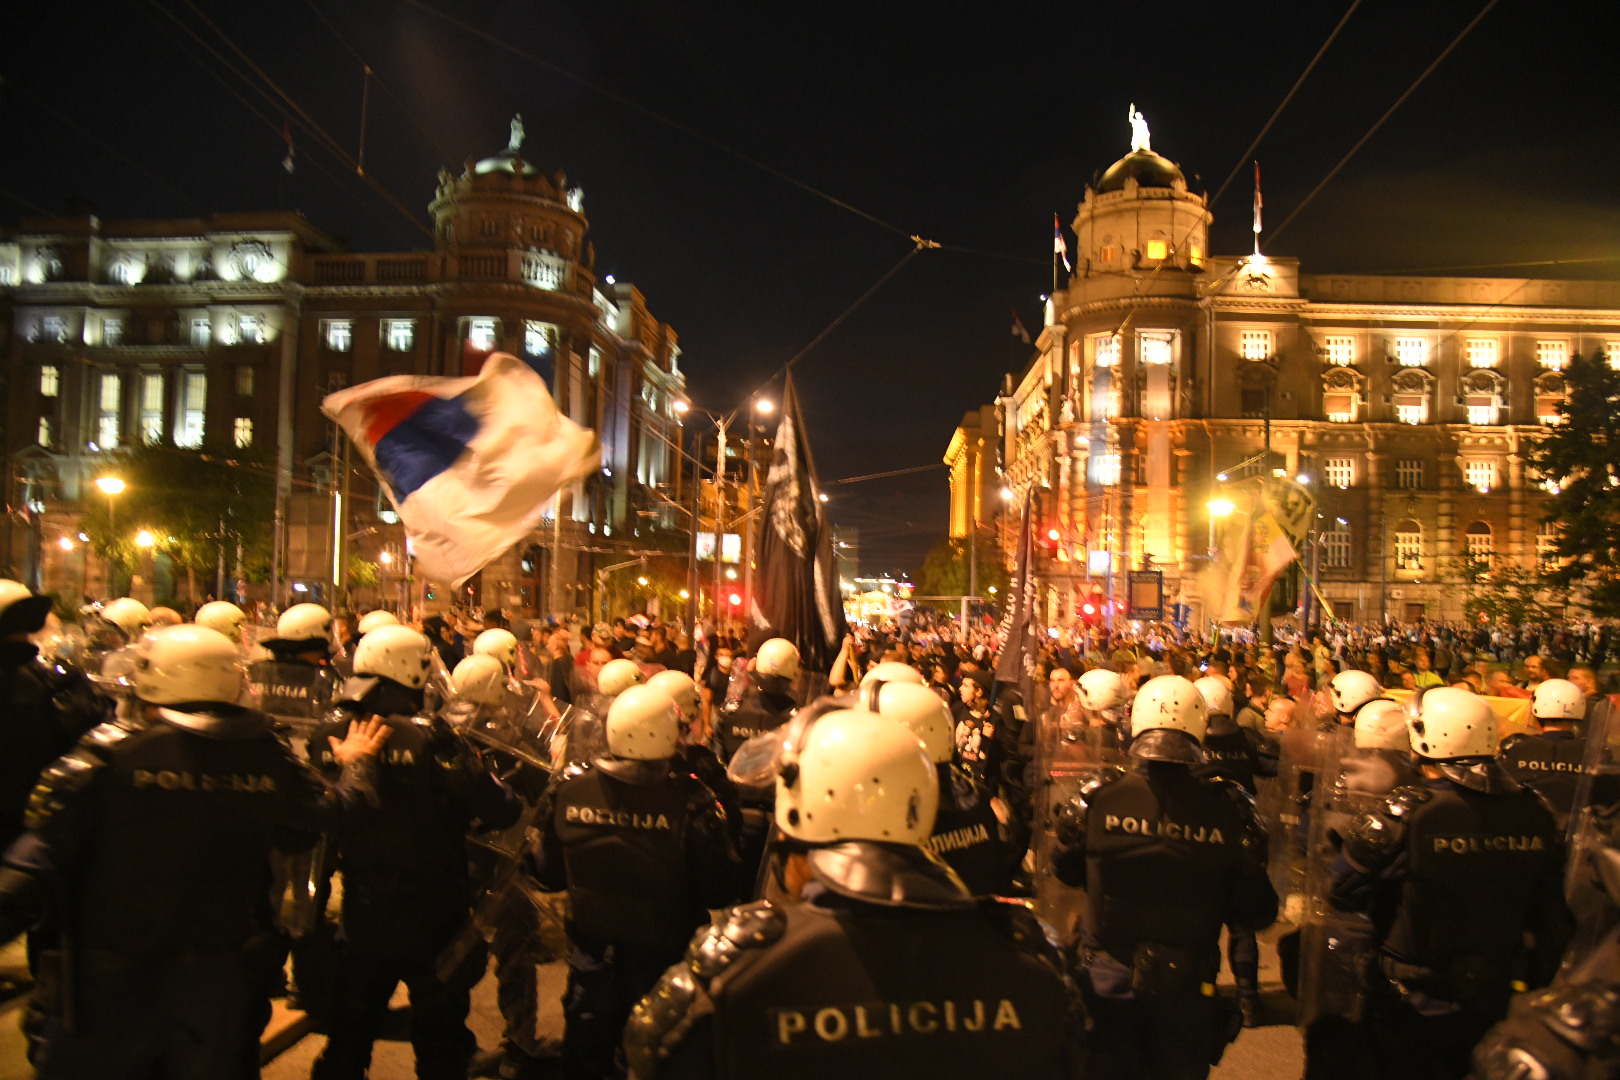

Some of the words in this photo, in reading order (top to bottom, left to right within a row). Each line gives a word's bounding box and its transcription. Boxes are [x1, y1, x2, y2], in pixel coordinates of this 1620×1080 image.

[1160, 702, 1168, 714] R
[926, 823, 990, 853] ЛИЦИЈА
[1104, 813, 1225, 845] POLICIJA
[1433, 834, 1545, 855] POLICIJA
[777, 998, 1023, 1046] POLICIJA
